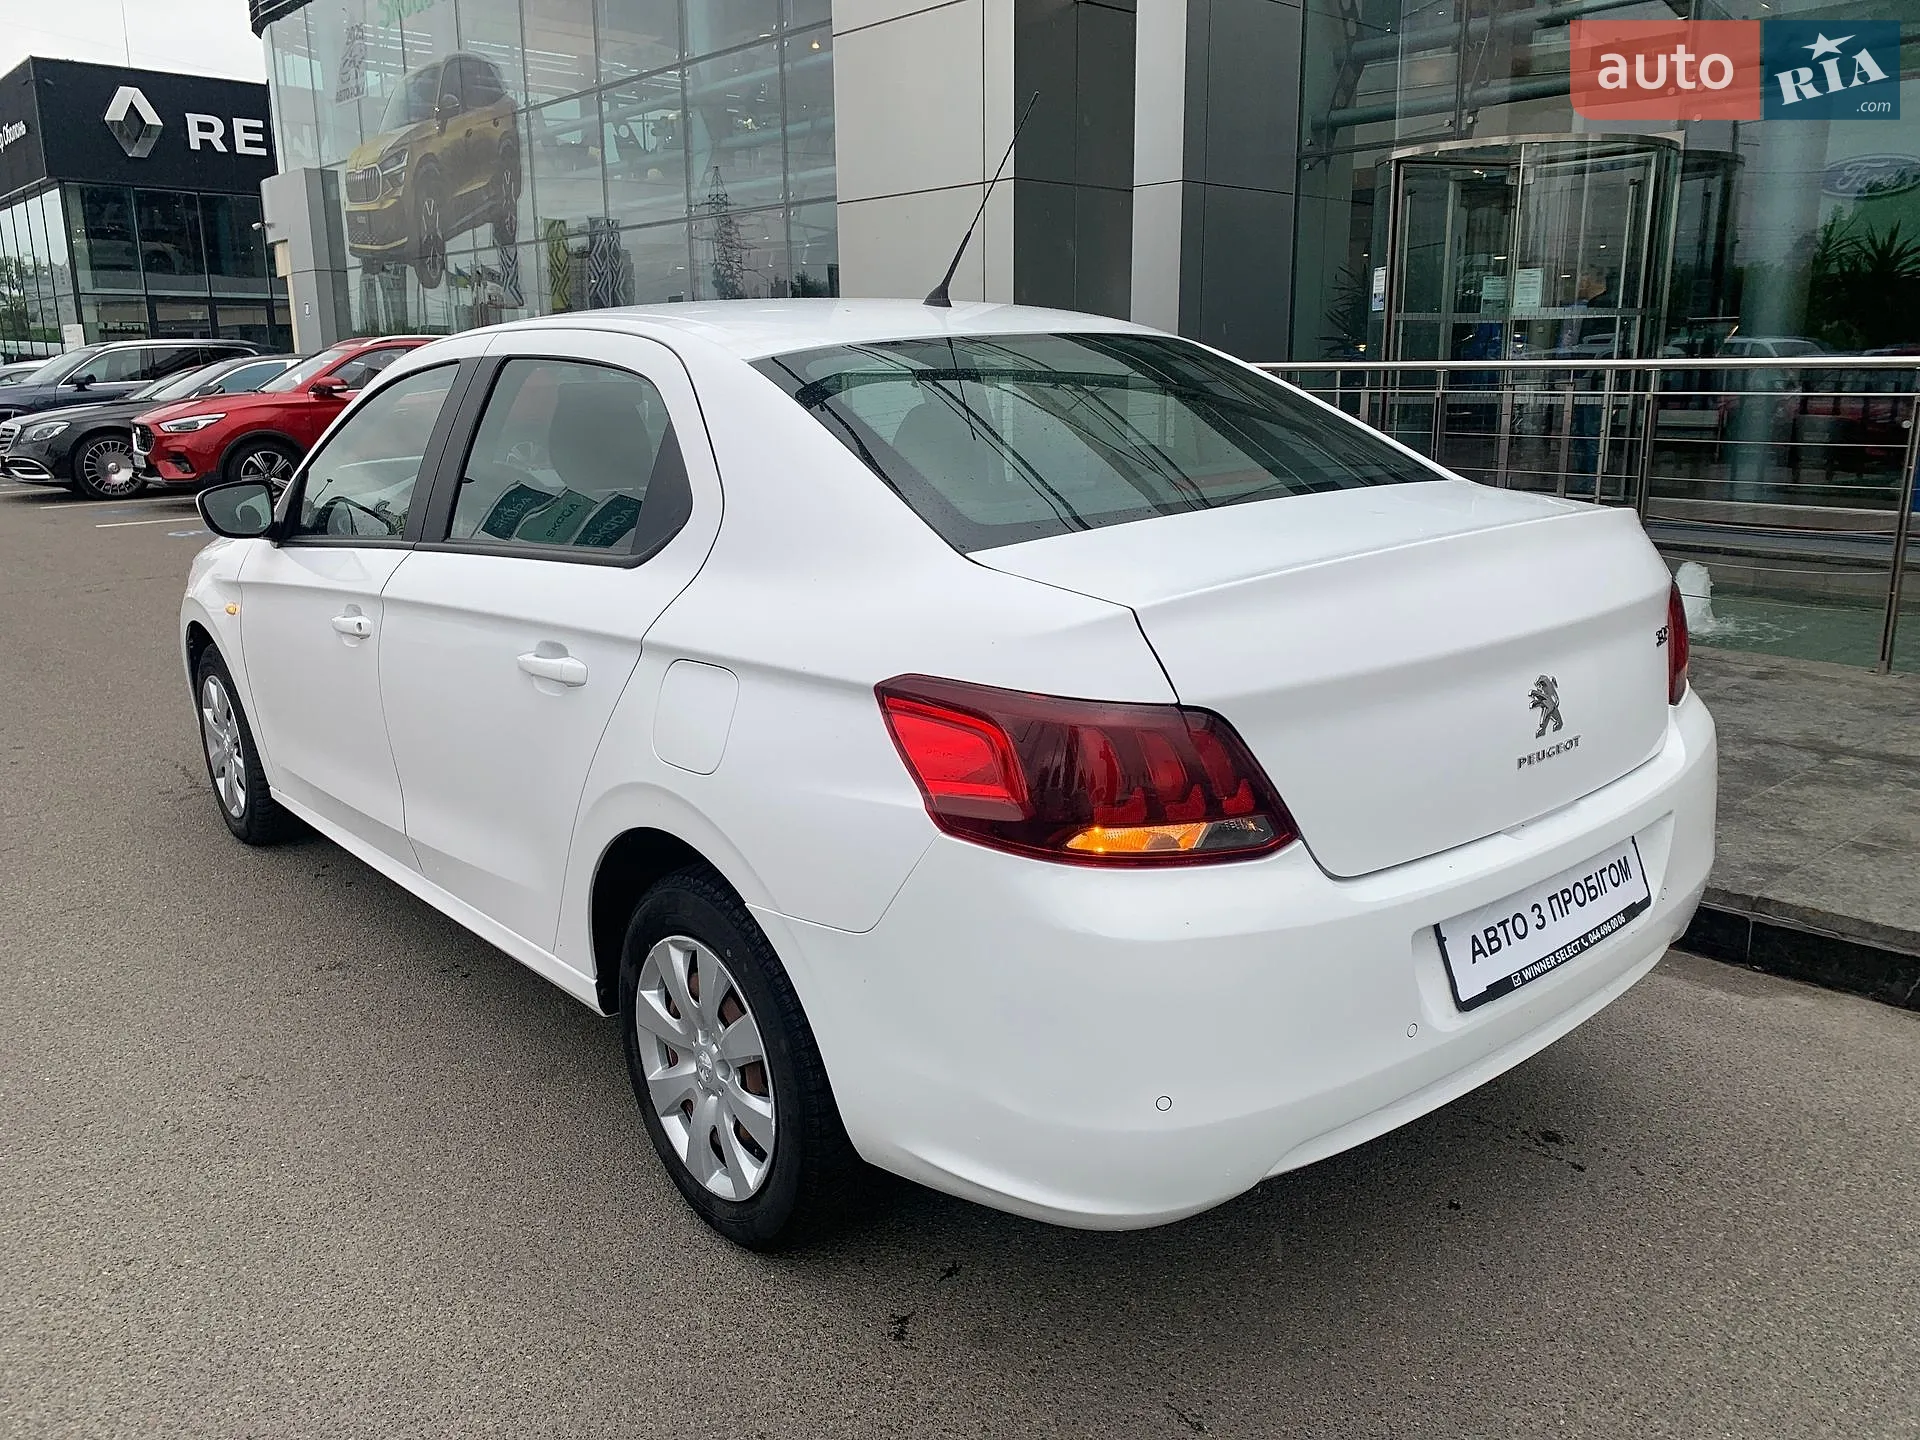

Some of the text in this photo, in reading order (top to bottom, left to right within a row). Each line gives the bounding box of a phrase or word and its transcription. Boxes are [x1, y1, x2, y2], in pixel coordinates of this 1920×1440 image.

[1517, 735, 1581, 769] PEUGEOT
[1471, 912, 1529, 965] АВТО
[1547, 856, 1633, 922] ПРОБІГОМ
[1521, 956, 1558, 981] WINNER
[1555, 941, 1581, 963] SELECT
[1588, 931, 1601, 944] 044
[1600, 924, 1612, 936] 496
[1611, 917, 1618, 930] 00
